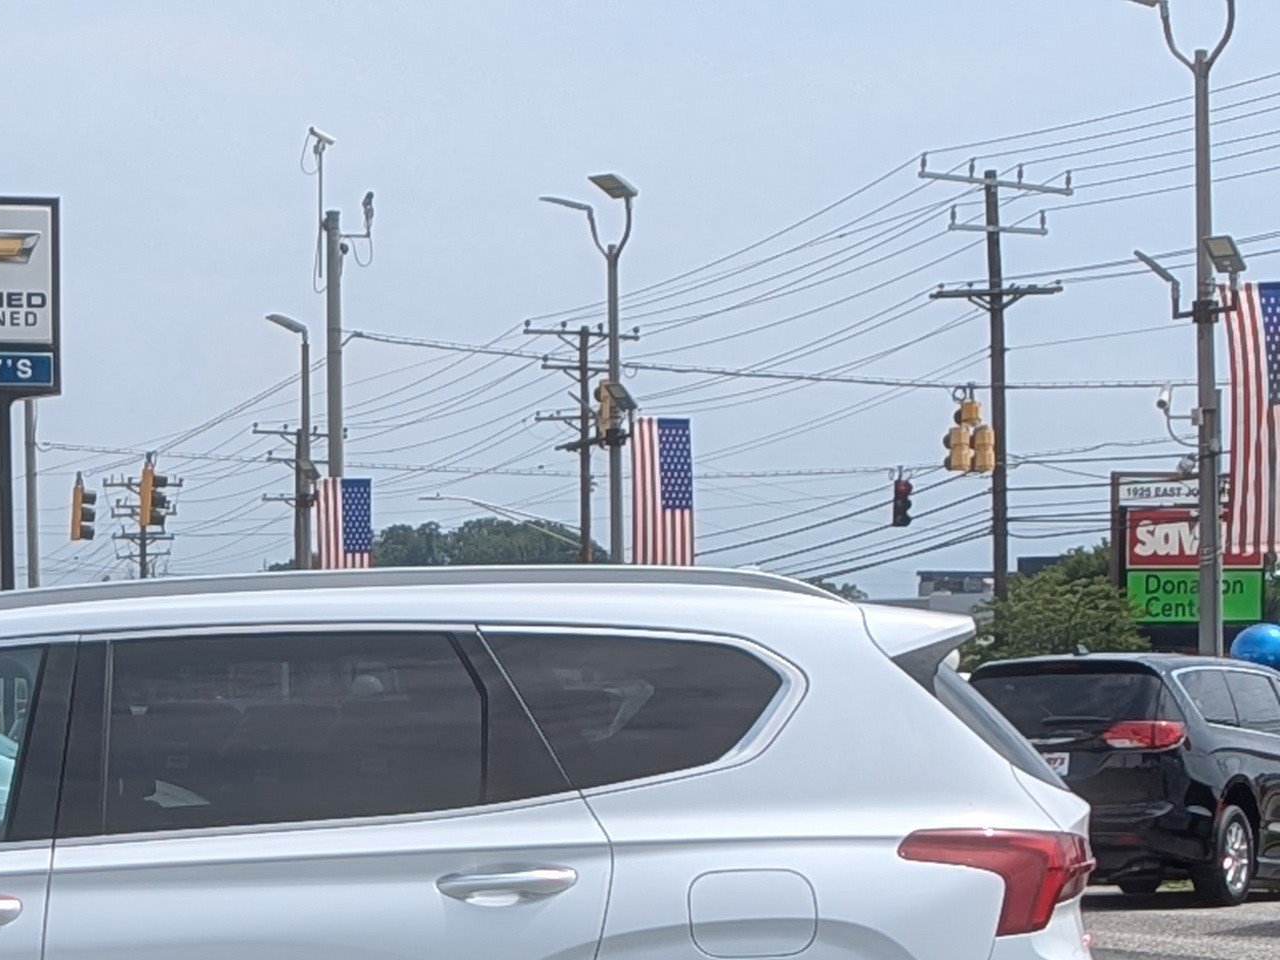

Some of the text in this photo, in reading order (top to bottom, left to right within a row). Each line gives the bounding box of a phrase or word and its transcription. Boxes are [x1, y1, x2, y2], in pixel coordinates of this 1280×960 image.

[1154, 486, 1182, 498] EAST
[1145, 574, 1244, 595] Donaon
[1146, 596, 1200, 617] Cent
